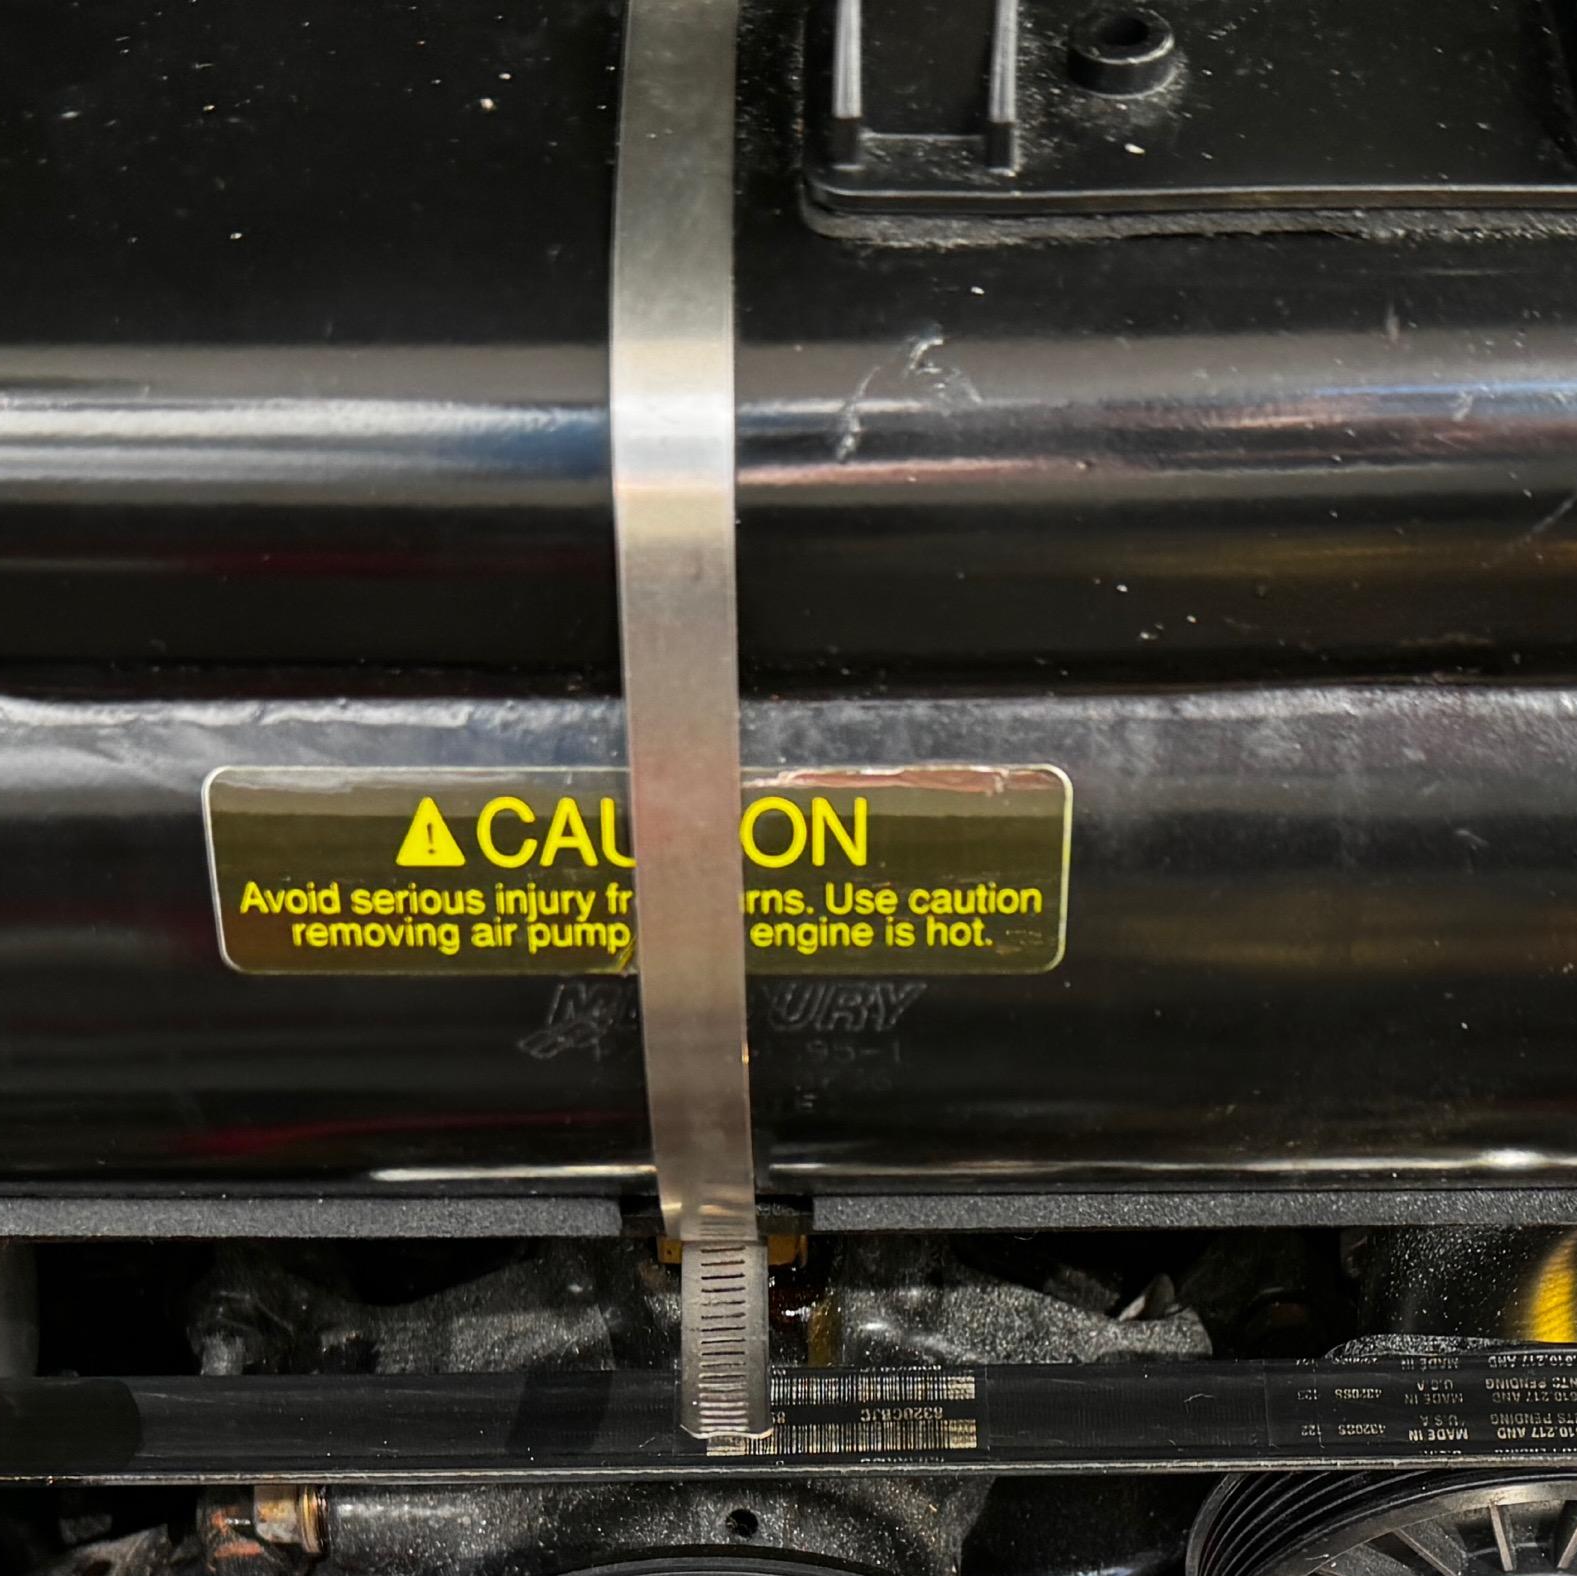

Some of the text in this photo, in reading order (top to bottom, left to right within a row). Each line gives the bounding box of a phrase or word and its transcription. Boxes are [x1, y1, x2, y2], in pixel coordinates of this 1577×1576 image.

[477, 796, 868, 868] CAUON
[240, 881, 340, 915] Avoid
[350, 881, 486, 915] serious
[496, 881, 596, 922] injury
[826, 882, 898, 915] Use
[908, 881, 1043, 915] caution
[292, 916, 993, 955] removing air pump engine is hot.
[1485, 1377, 1547, 1390] PENDING
[1423, 1393, 1463, 1405] MADE
[1490, 1412, 1552, 1425] PENDING
[1408, 1429, 1469, 1442] MADE IN
[1497, 1427, 1526, 1439] AND
